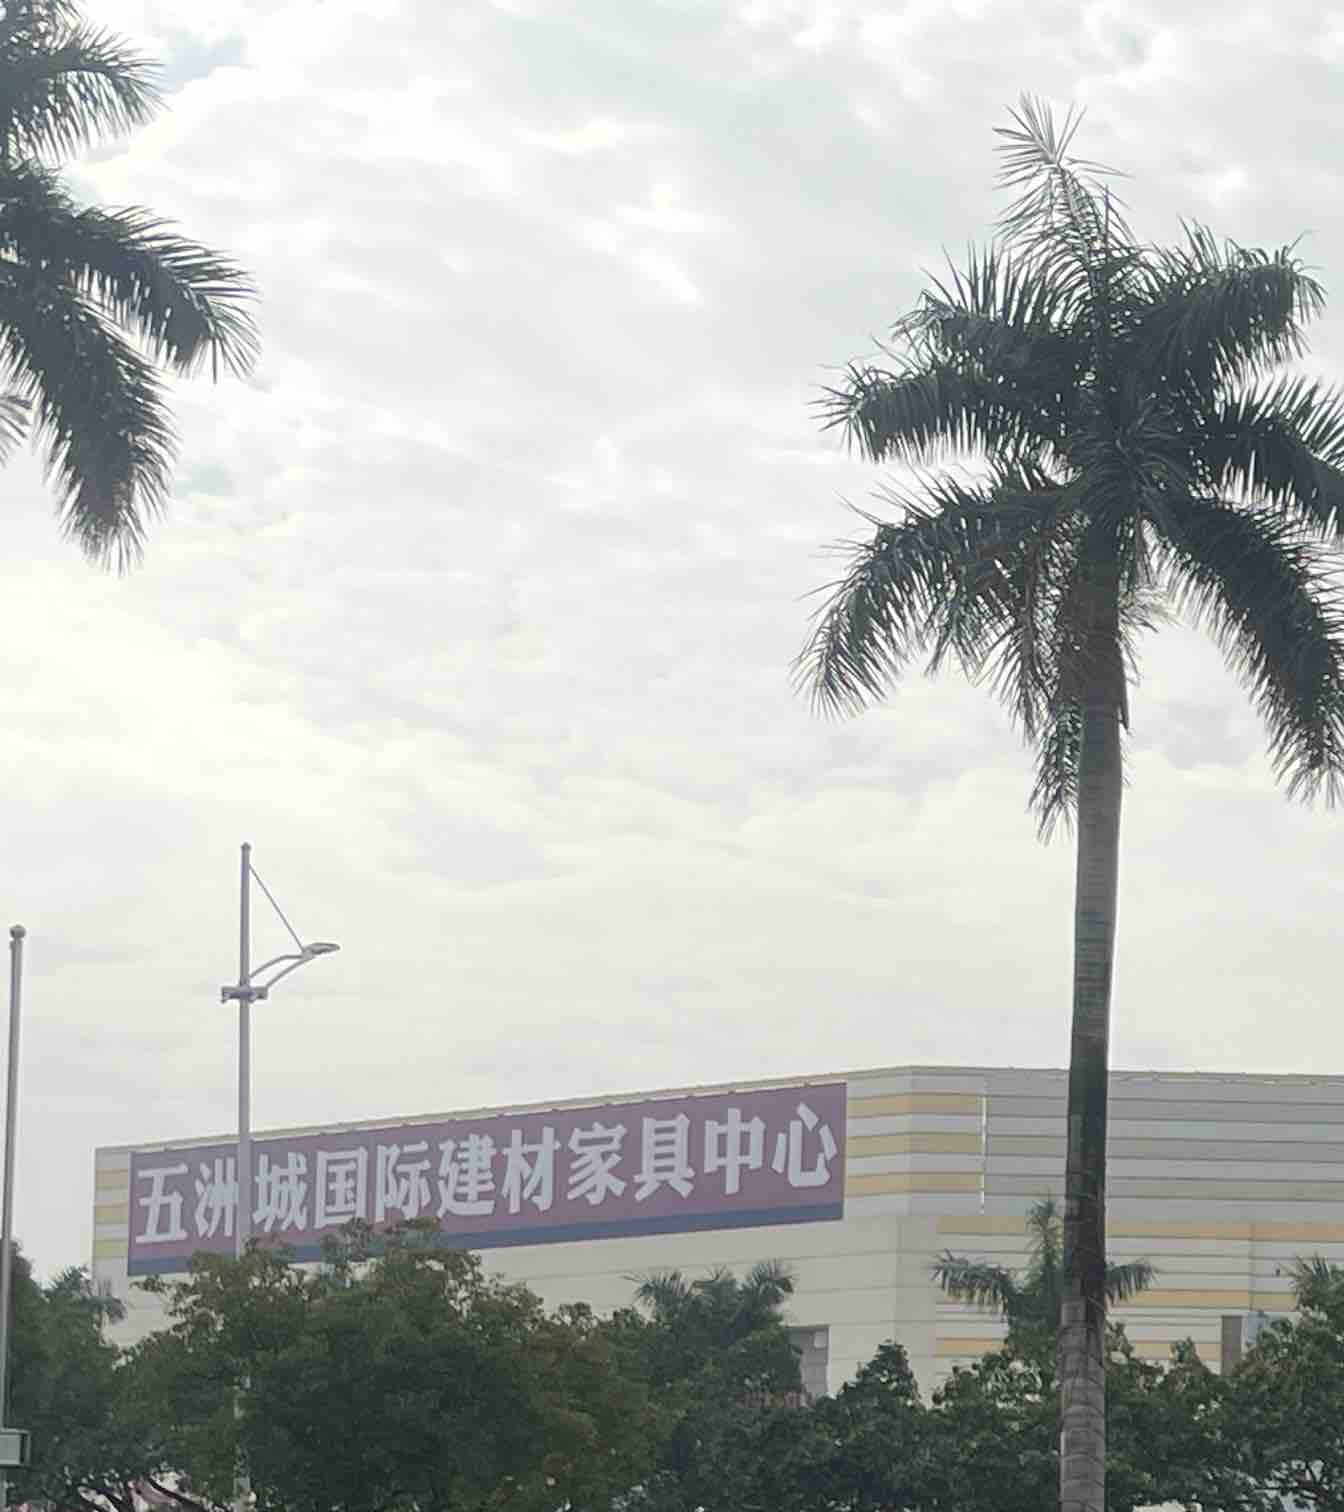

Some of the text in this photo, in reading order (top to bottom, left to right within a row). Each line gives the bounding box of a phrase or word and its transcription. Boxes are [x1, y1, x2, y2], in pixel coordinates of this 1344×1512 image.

[135, 1102, 838, 1245] 五洲城国际建材家具中心
